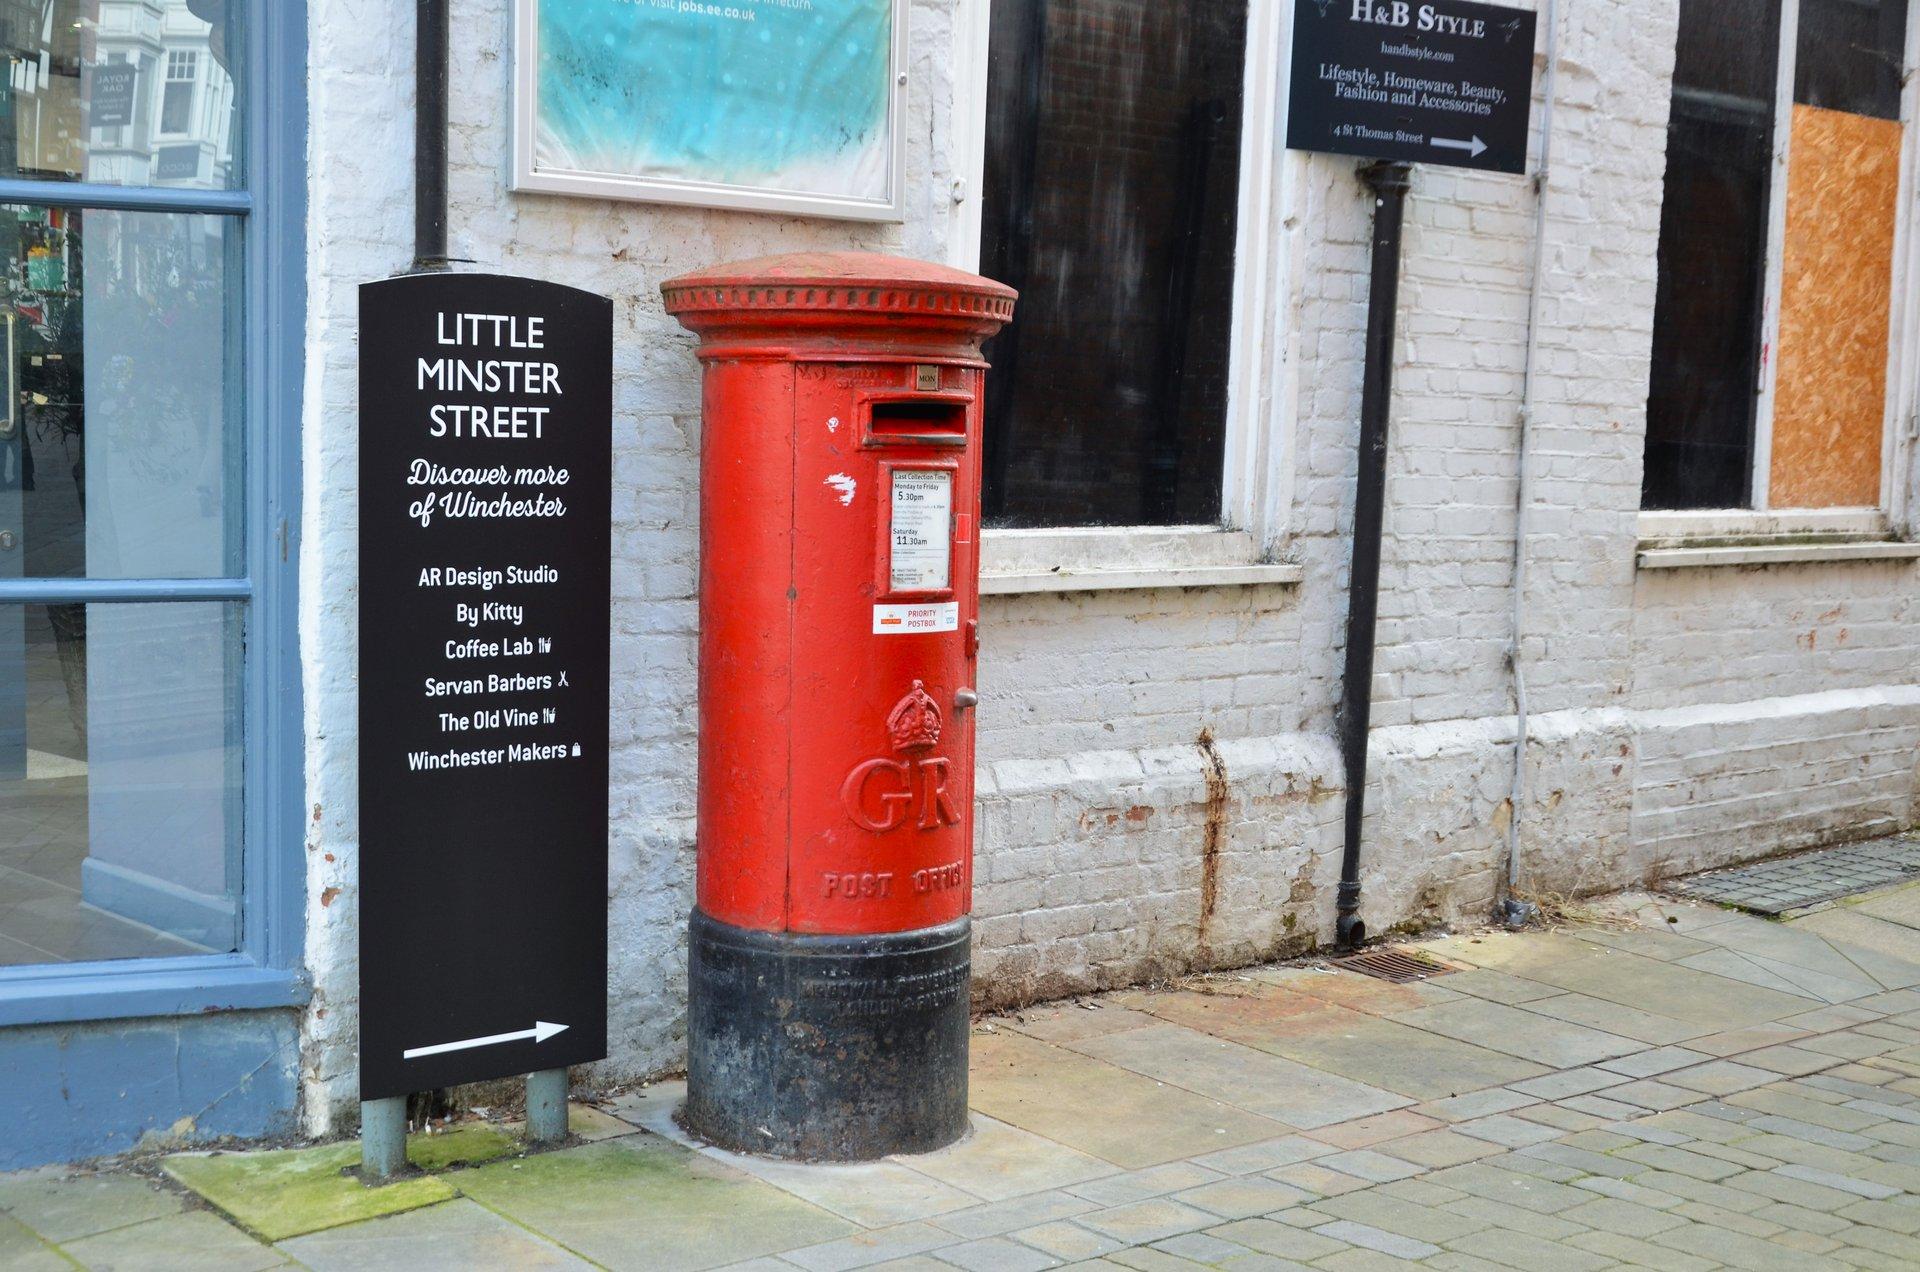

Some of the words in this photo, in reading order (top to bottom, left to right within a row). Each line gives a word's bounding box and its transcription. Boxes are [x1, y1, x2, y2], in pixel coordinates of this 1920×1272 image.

[678, 0, 755, 21] jobs.ee.co.uk
[1350, 0, 1410, 28] H&B
[1380, 41, 1454, 62] handbstyle.com
[1319, 63, 1380, 87] Lifestyle,
[1384, 72, 1457, 97] Homeware,
[1462, 81, 1507, 104] Beauty,
[1335, 82, 1388, 101] Fashion
[1392, 88, 1416, 105] and
[1419, 93, 1492, 116] Accessories
[1334, 126, 1341, 137] 4
[1343, 124, 1353, 135] St
[1355, 124, 1393, 140] Thomas
[1395, 129, 1424, 144] Street
[438, 312, 544, 348] LITTLE
[418, 357, 563, 394] MINSTER
[919, 375, 936, 383] MON
[430, 404, 549, 438] STREET
[407, 458, 511, 485] Discover
[514, 465, 570, 485] more
[894, 473, 907, 481] Last
[907, 473, 934, 481] Collection
[894, 483, 916, 491] Monday
[923, 483, 939, 492] Friday
[898, 490, 924, 502] 5.30pm
[409, 492, 436, 527] of
[438, 490, 567, 518] Winchester
[893, 528, 918, 536] Saturday
[896, 536, 928, 546] 11.30am
[418, 567, 441, 587] AR
[446, 566, 503, 591] Design
[506, 564, 559, 585] Studio
[456, 603, 478, 628] By
[483, 602, 523, 626] Kitty
[907, 609, 937, 618] PRIORITY
[907, 619, 937, 628] POSTBOX
[445, 639, 499, 659] Coffee
[503, 637, 533, 656] Lab
[425, 678, 484, 697] Servan
[488, 673, 552, 693] Barbers
[439, 712, 470, 732] The
[473, 710, 500, 730] Old
[503, 708, 539, 728] Vine
[408, 749, 505, 771] Winchester
[508, 742, 567, 763] Makers
[824, 872, 893, 898] POST
